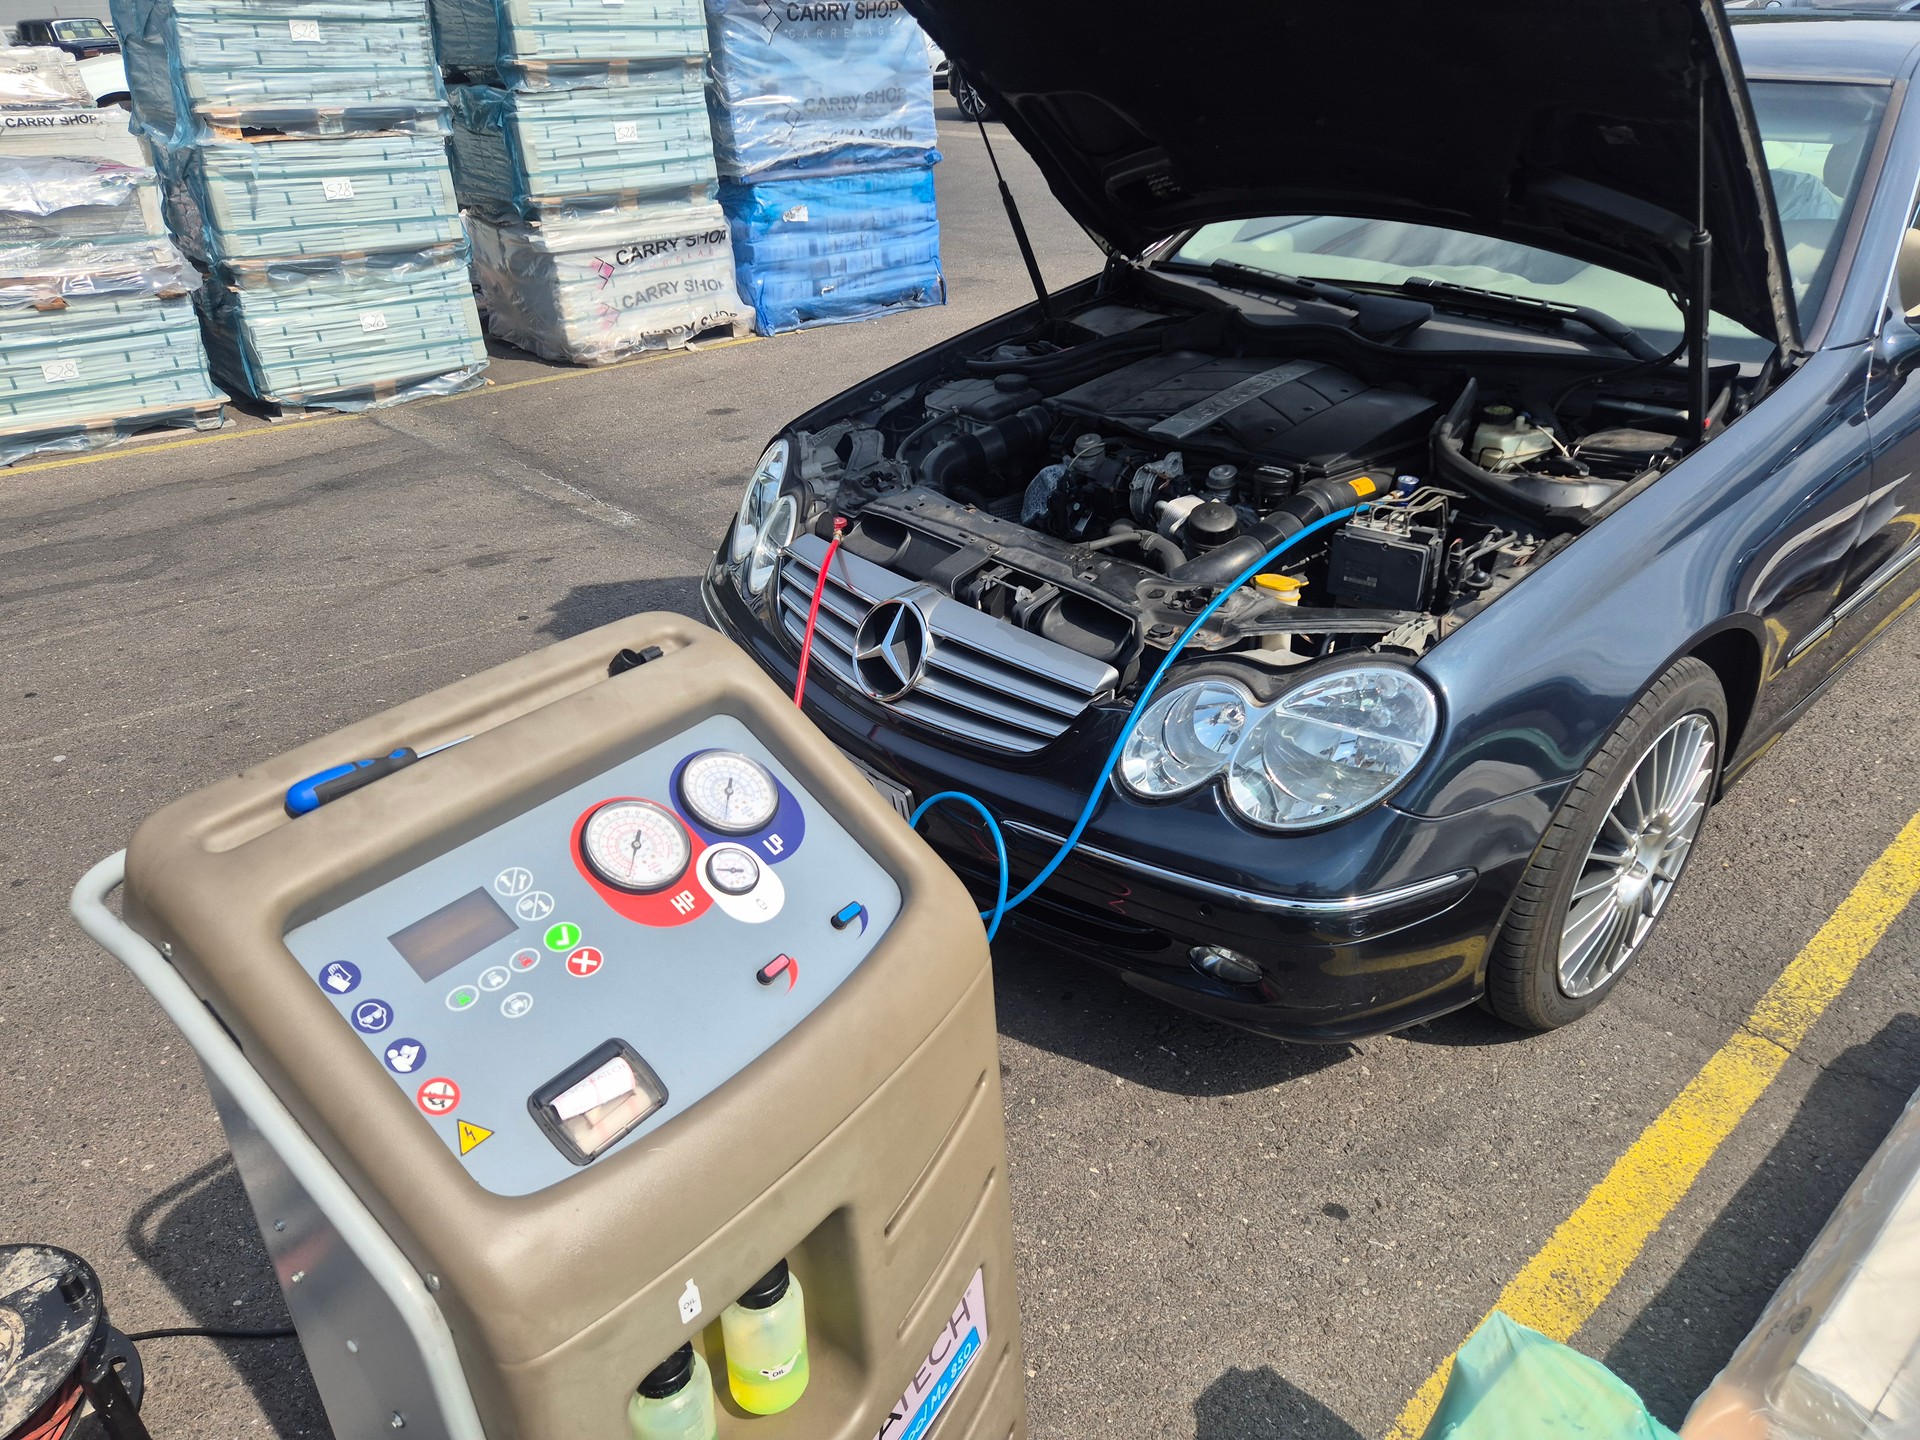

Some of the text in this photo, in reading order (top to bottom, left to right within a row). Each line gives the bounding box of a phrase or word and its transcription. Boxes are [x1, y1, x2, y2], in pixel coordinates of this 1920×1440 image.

[786, 1, 899, 22] CARRY SHOP
[804, 95, 861, 113] CARRY
[5, 114, 97, 129] CARRY SHOP
[617, 126, 636, 140] S28
[326, 182, 351, 199] S28
[616, 237, 682, 266] CARRY
[622, 280, 679, 309] CARRY
[362, 315, 384, 330] S28
[45, 363, 76, 381] S28
[761, 833, 785, 856] LP
[670, 889, 696, 916] HP
[683, 1299, 697, 1310] OIL
[772, 1369, 786, 1378] OIL
[930, 1382, 949, 1412] Me
[950, 1342, 972, 1379] 850
